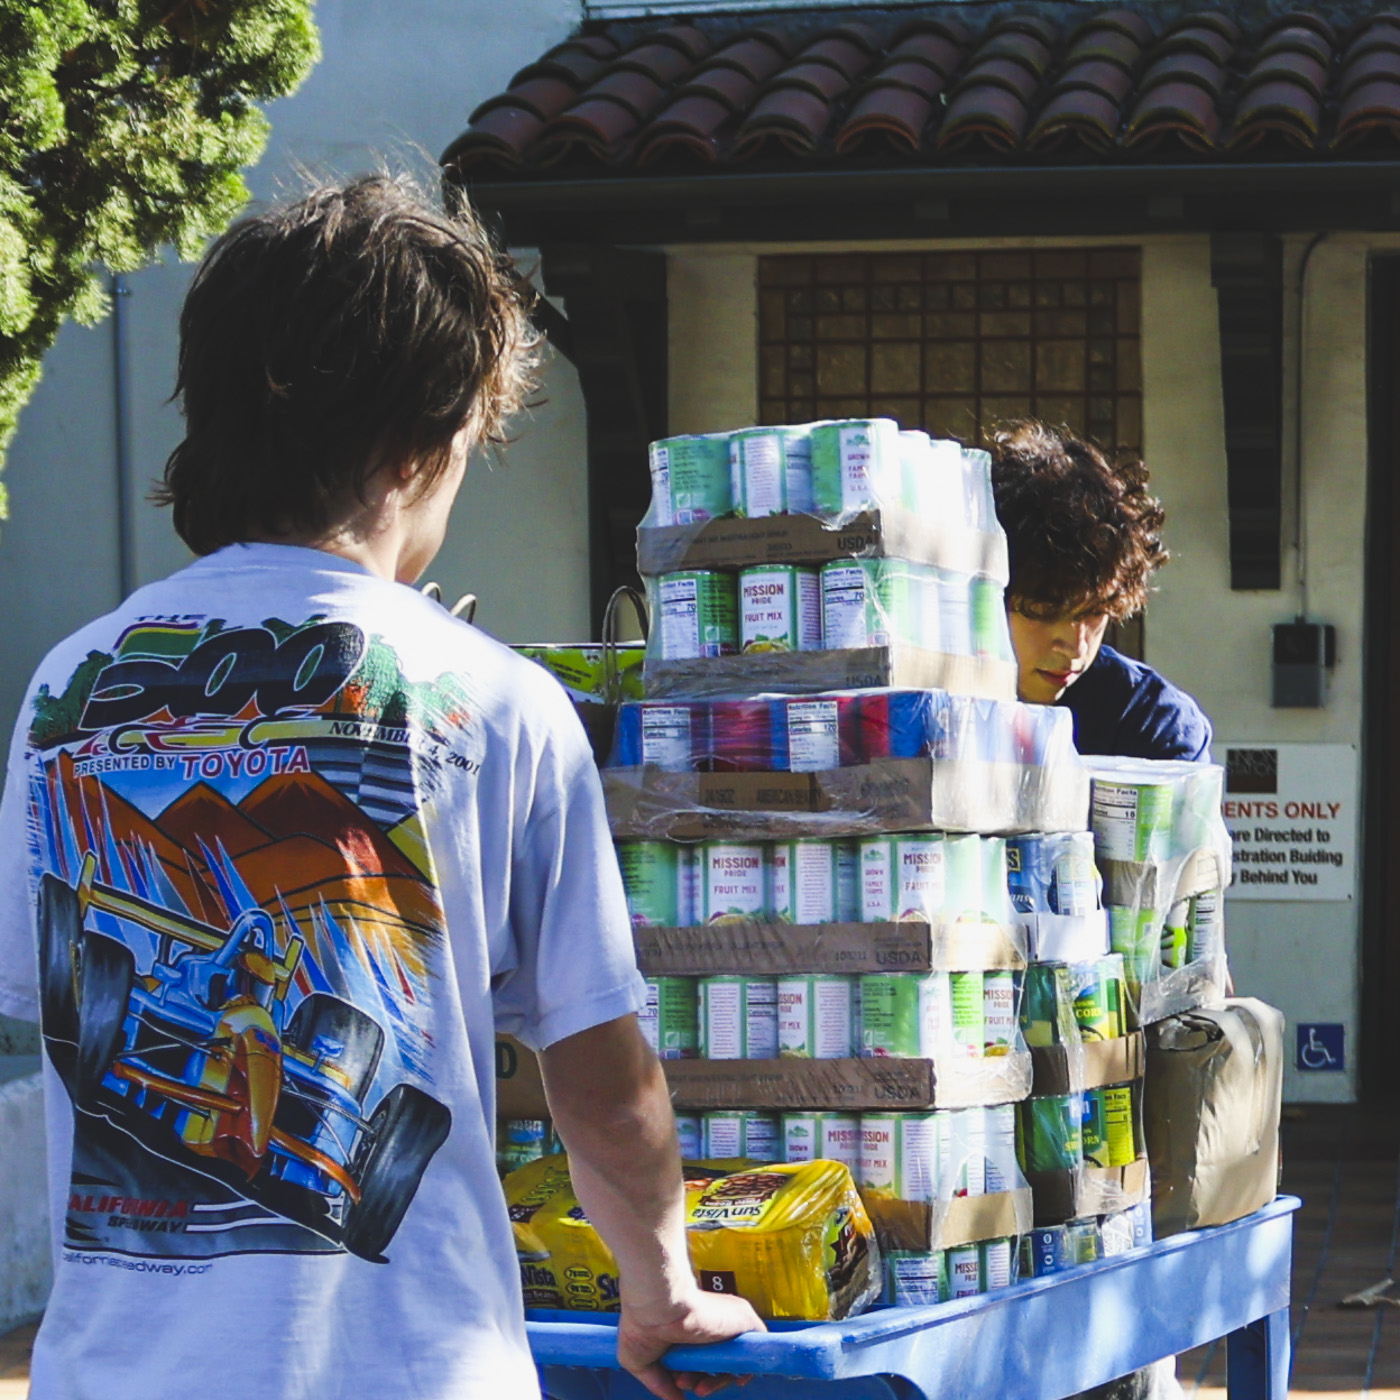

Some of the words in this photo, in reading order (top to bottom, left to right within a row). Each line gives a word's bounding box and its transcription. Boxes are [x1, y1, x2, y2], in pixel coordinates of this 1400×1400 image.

[744, 584, 784, 598] MISSION
[745, 613, 764, 623] FRUIT
[767, 612, 783, 621] MIX
[73, 755, 150, 777] PRESENTED
[153, 754, 176, 771] BY
[180, 745, 312, 781] TOYOTA
[445, 751, 481, 776] 2001
[1221, 801, 1279, 819] ENTS
[1284, 801, 1341, 819] ONLY
[1254, 828, 1312, 842] Directed
[1316, 828, 1331, 842] to
[712, 856, 760, 870] MISSION
[1232, 850, 1286, 863] stration
[723, 869, 748, 878] PRIDE
[1240, 870, 1288, 884] Behind
[1292, 870, 1318, 884] You
[714, 885, 738, 895] FRUIT
[742, 885, 759, 894] MIX
[875, 951, 922, 965] USDA
[779, 992, 802, 1004] SSION
[984, 989, 1013, 1001] MISSIO
[862, 1131, 889, 1143] SSION
[874, 1159, 887, 1168] MIX
[955, 1261, 978, 1274] MISSI
[521, 1264, 557, 1288] Vista
[711, 1275, 724, 1292] 8
